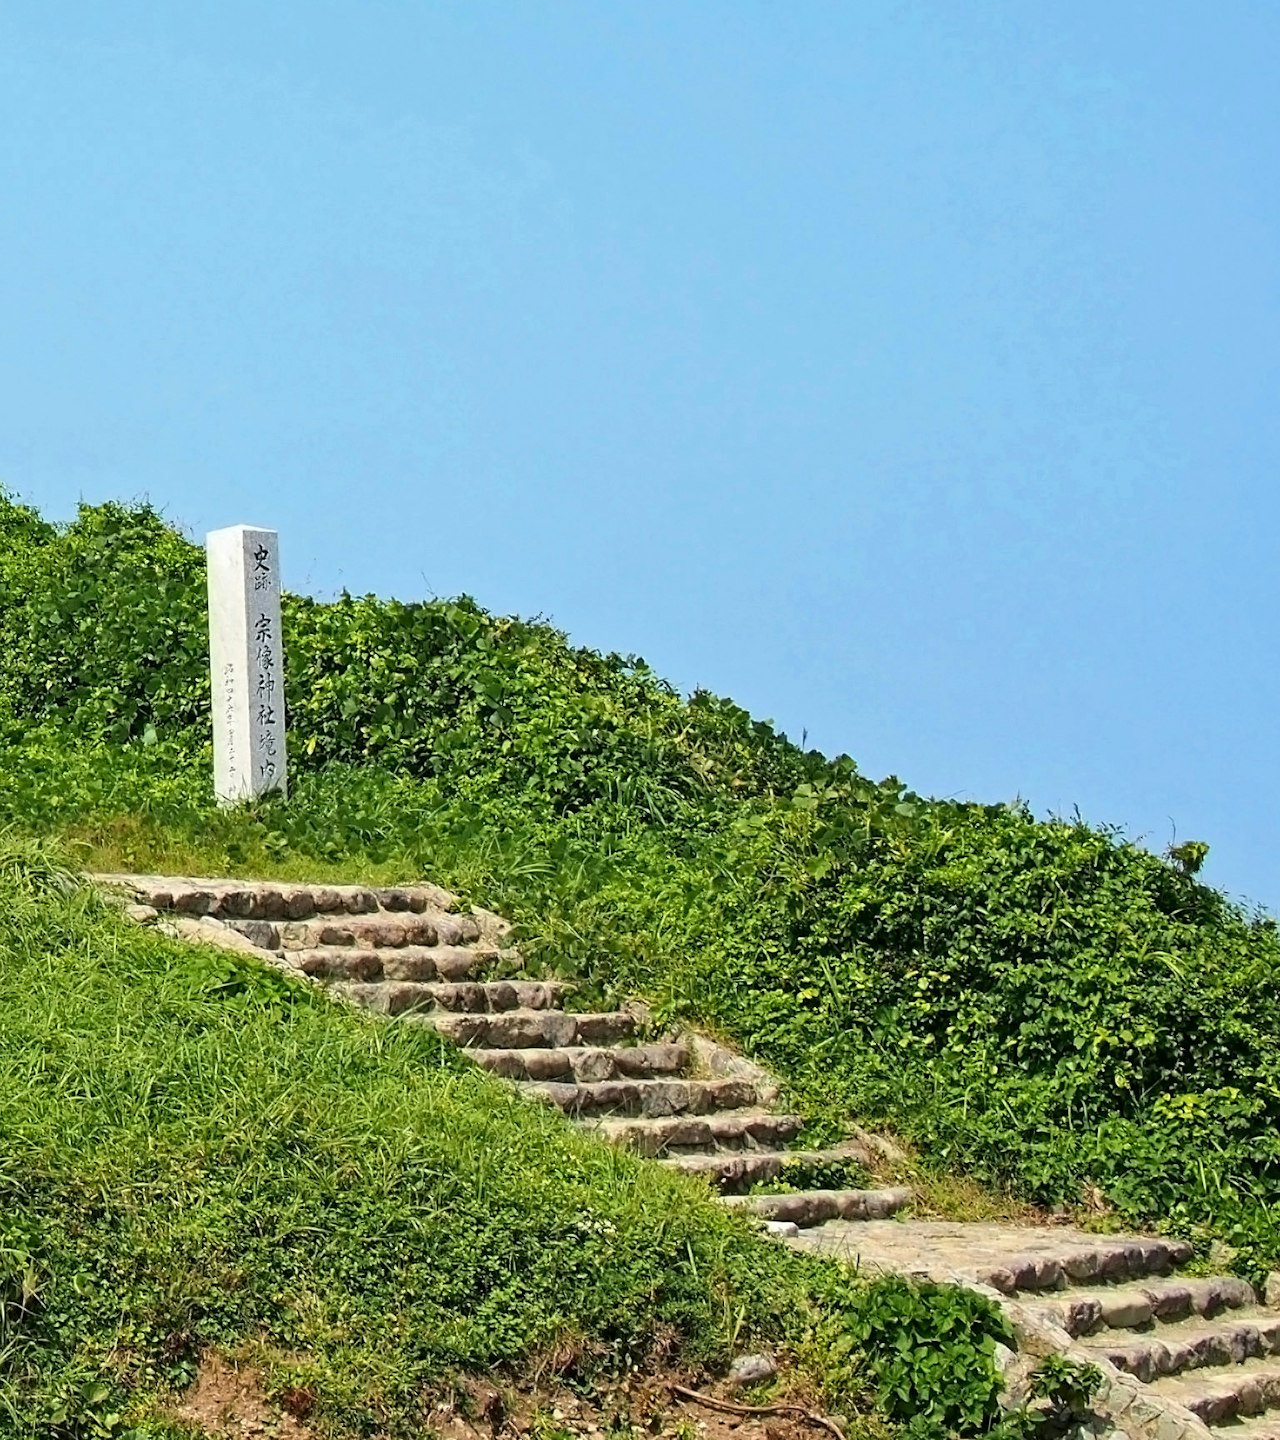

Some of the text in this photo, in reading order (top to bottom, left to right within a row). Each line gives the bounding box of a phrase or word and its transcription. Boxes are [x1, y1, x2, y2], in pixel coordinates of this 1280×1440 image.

[253, 544, 277, 779] 史跡 宗像神社境内
